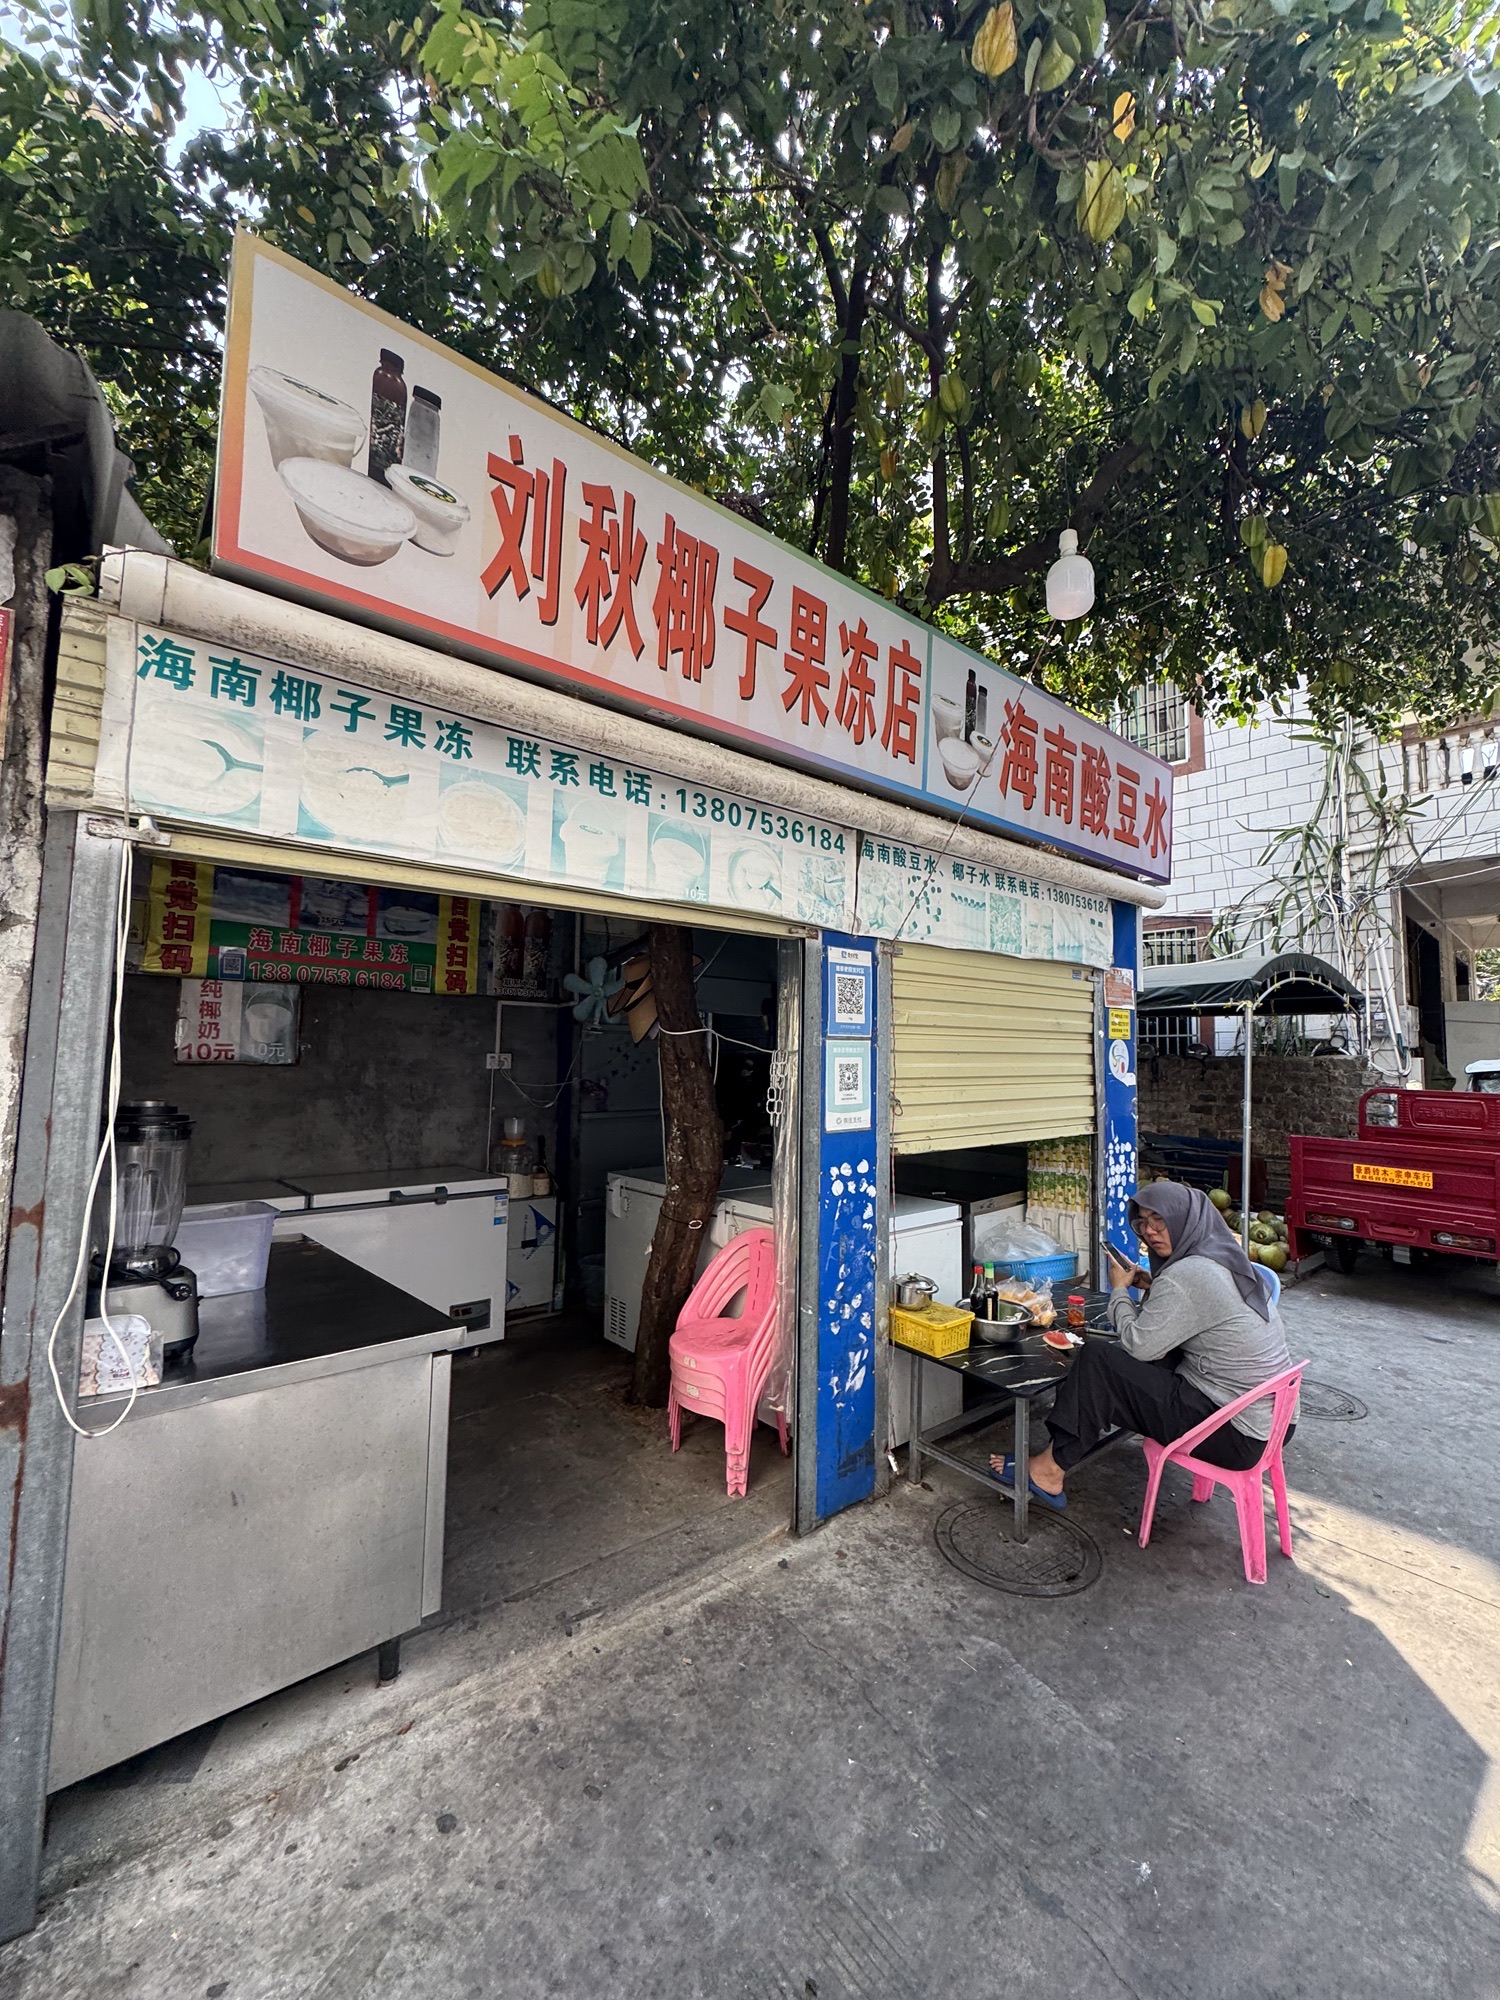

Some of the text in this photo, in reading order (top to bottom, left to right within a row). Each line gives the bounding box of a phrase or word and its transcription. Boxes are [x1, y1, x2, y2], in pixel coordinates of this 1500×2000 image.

[480, 434, 922, 764] 刘秋椰子果冻店
[137, 633, 474, 760] 海南椰子果冻
[1000, 698, 1168, 859] 海南酸豆水
[862, 838, 990, 888] 海南酸豆水、椰子水
[160, 859, 198, 974] 自觉扫码
[249, 928, 409, 964] 海南椰子果冻
[445, 897, 470, 994] 自觉扫码
[249, 962, 405, 990] 138 0753 6184
[197, 980, 223, 1040] 纯椰奶
[181, 1043, 235, 1061] 10元
[250, 1043, 286, 1058] 10元
